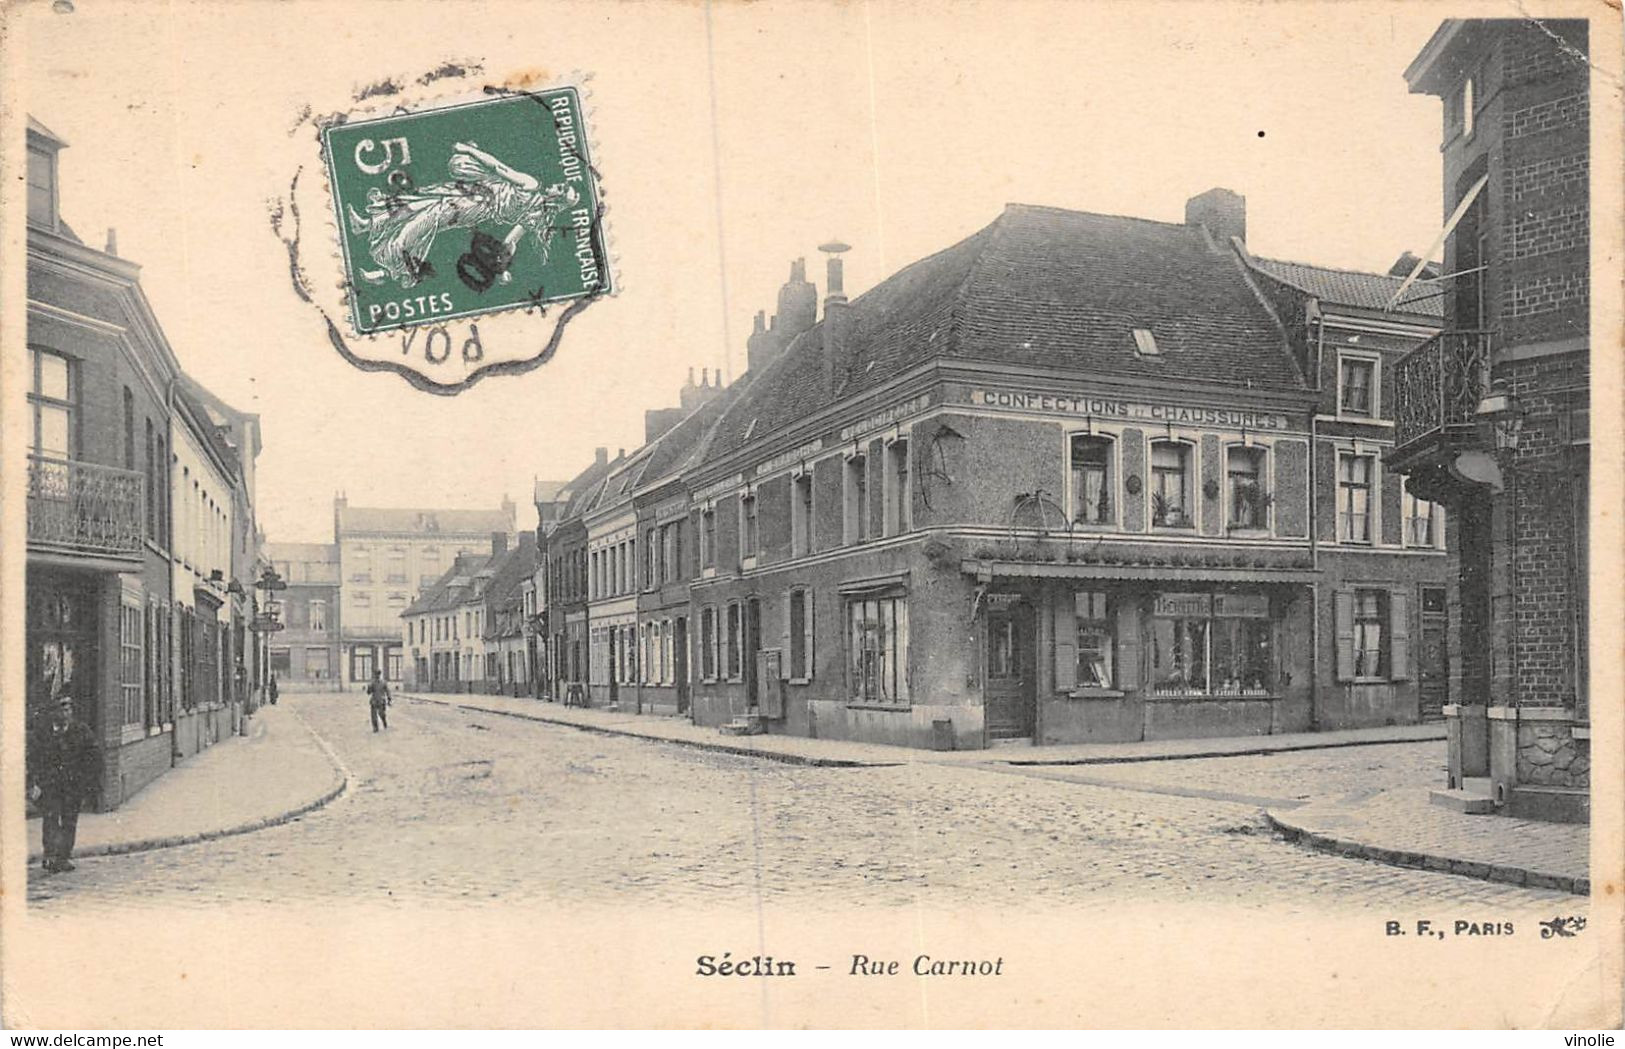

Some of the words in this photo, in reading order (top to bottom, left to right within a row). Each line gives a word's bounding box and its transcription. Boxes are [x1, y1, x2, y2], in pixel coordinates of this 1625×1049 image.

[369, 292, 453, 323] POSTES
[984, 390, 1128, 416] CONFECTIONS
[1151, 405, 1278, 428] CHAUSSURES
